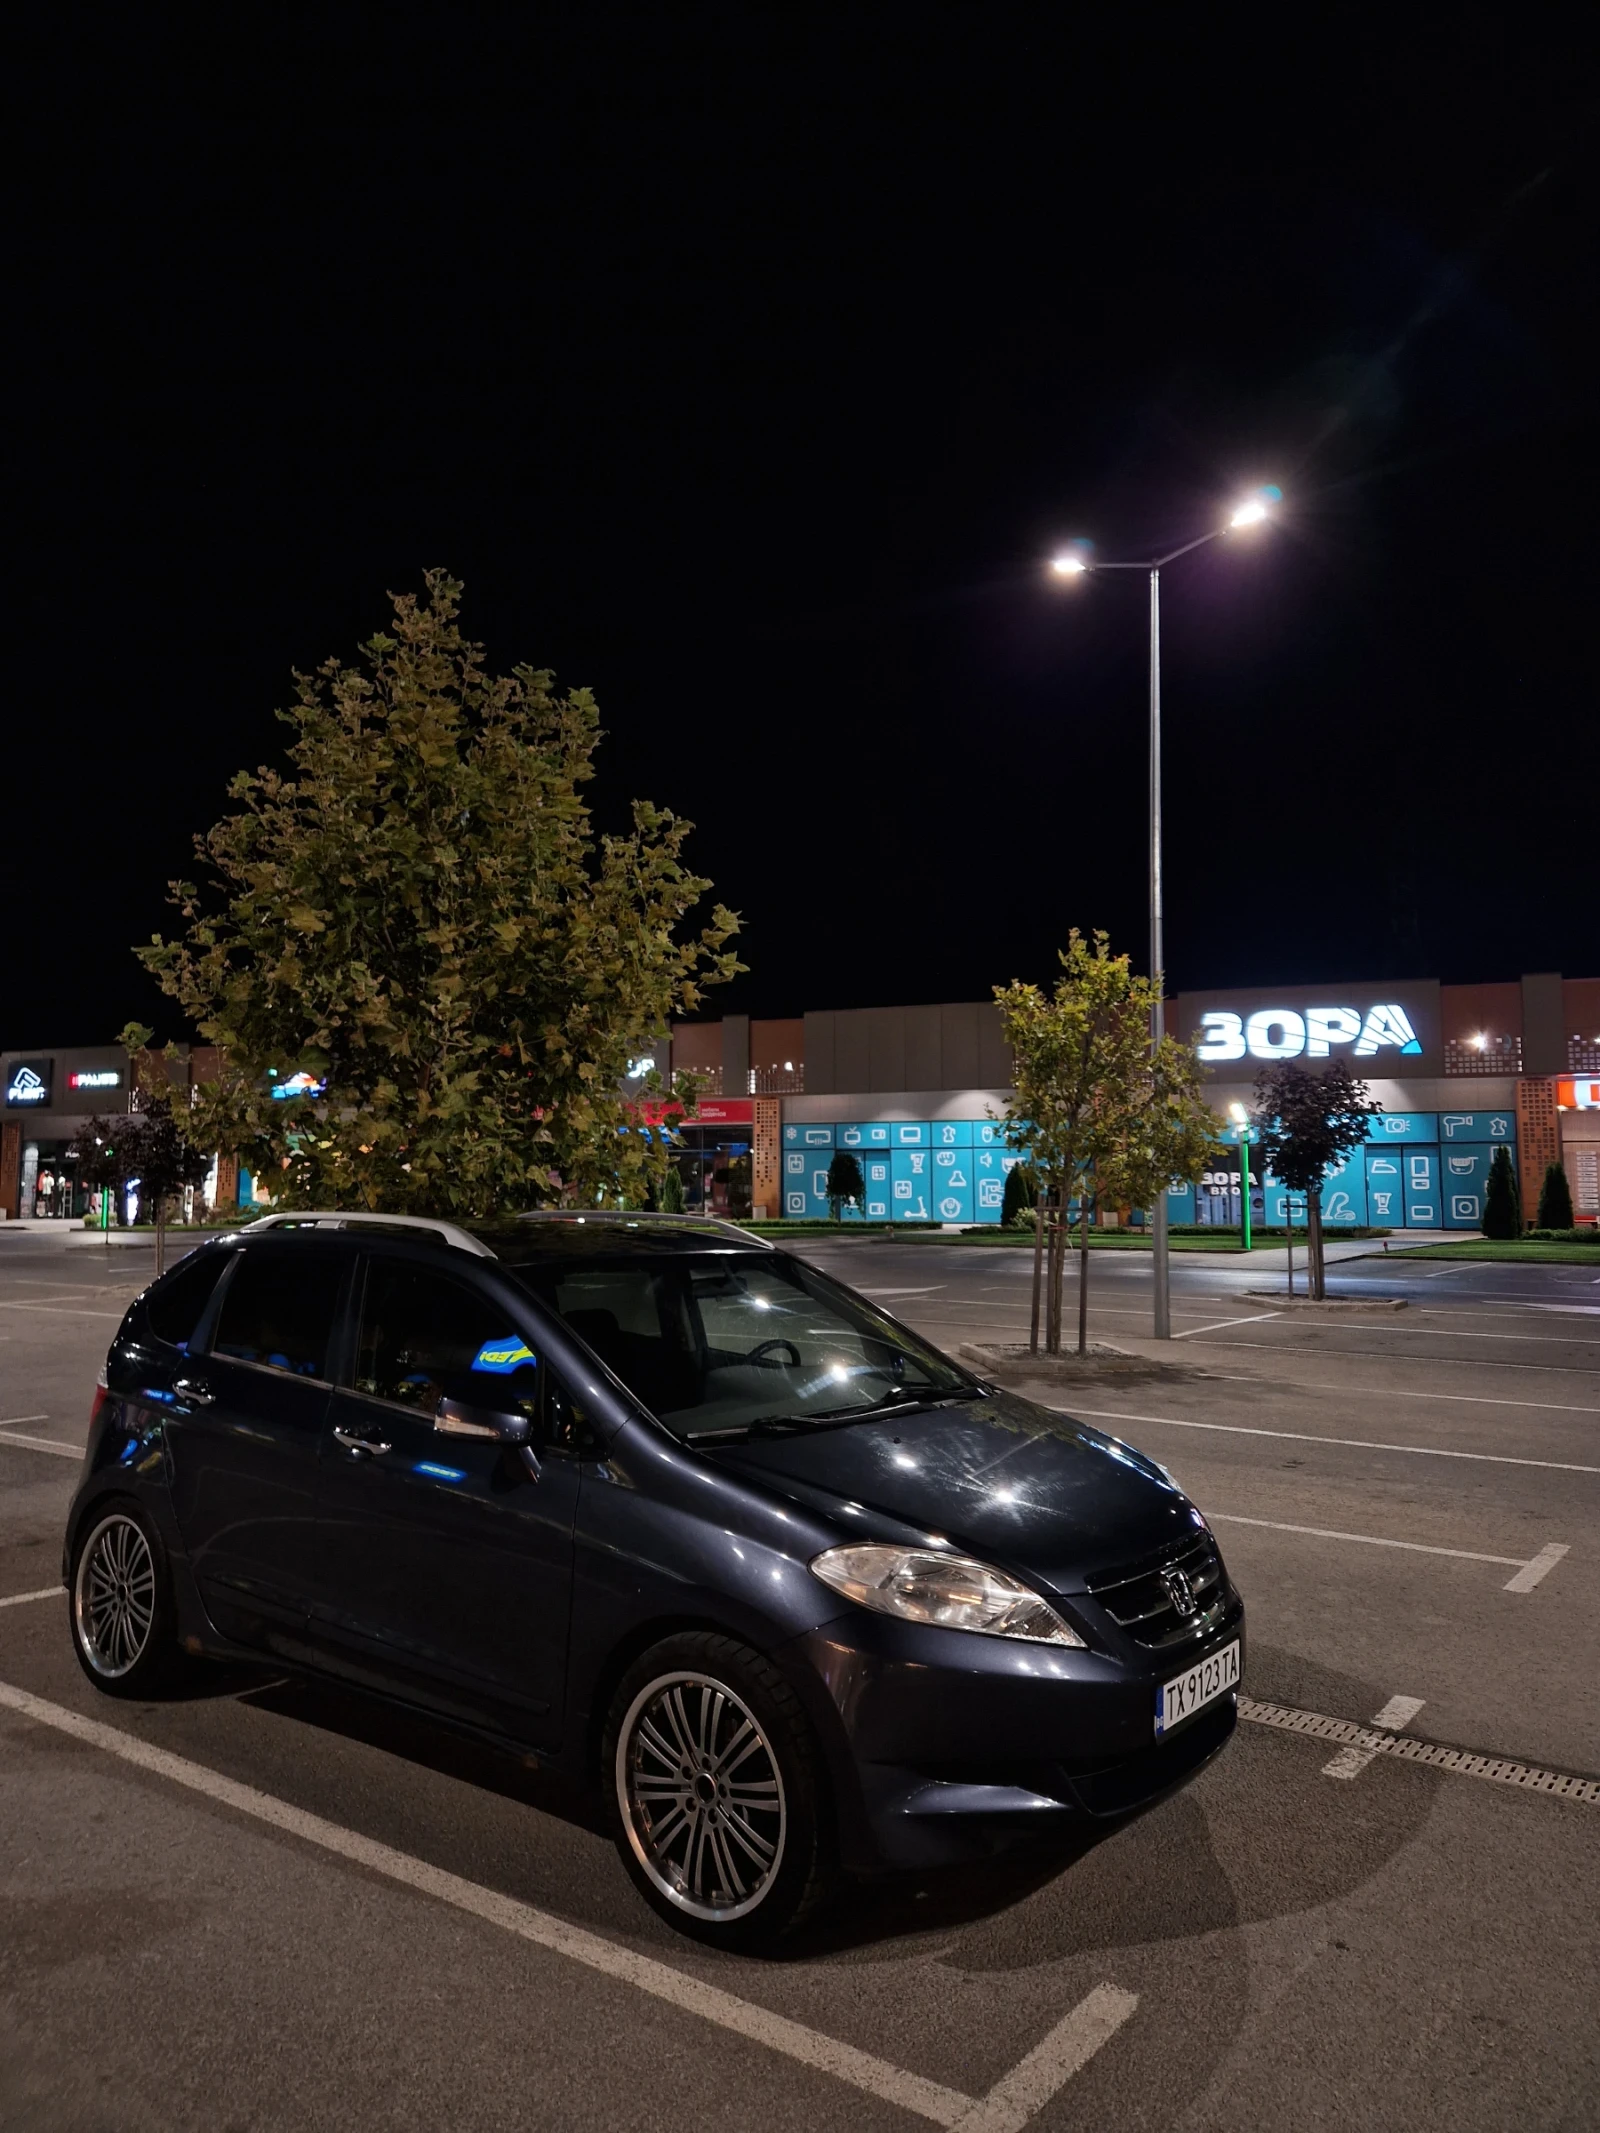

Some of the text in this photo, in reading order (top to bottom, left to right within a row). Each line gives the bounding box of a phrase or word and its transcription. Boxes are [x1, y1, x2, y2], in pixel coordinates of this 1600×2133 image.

[1198, 1004, 1423, 1060] ЗОРА
[1210, 1186, 1250, 1196] ВХО
[1188, 1658, 1220, 1708] 9123
[1222, 1647, 1237, 1684] TA
